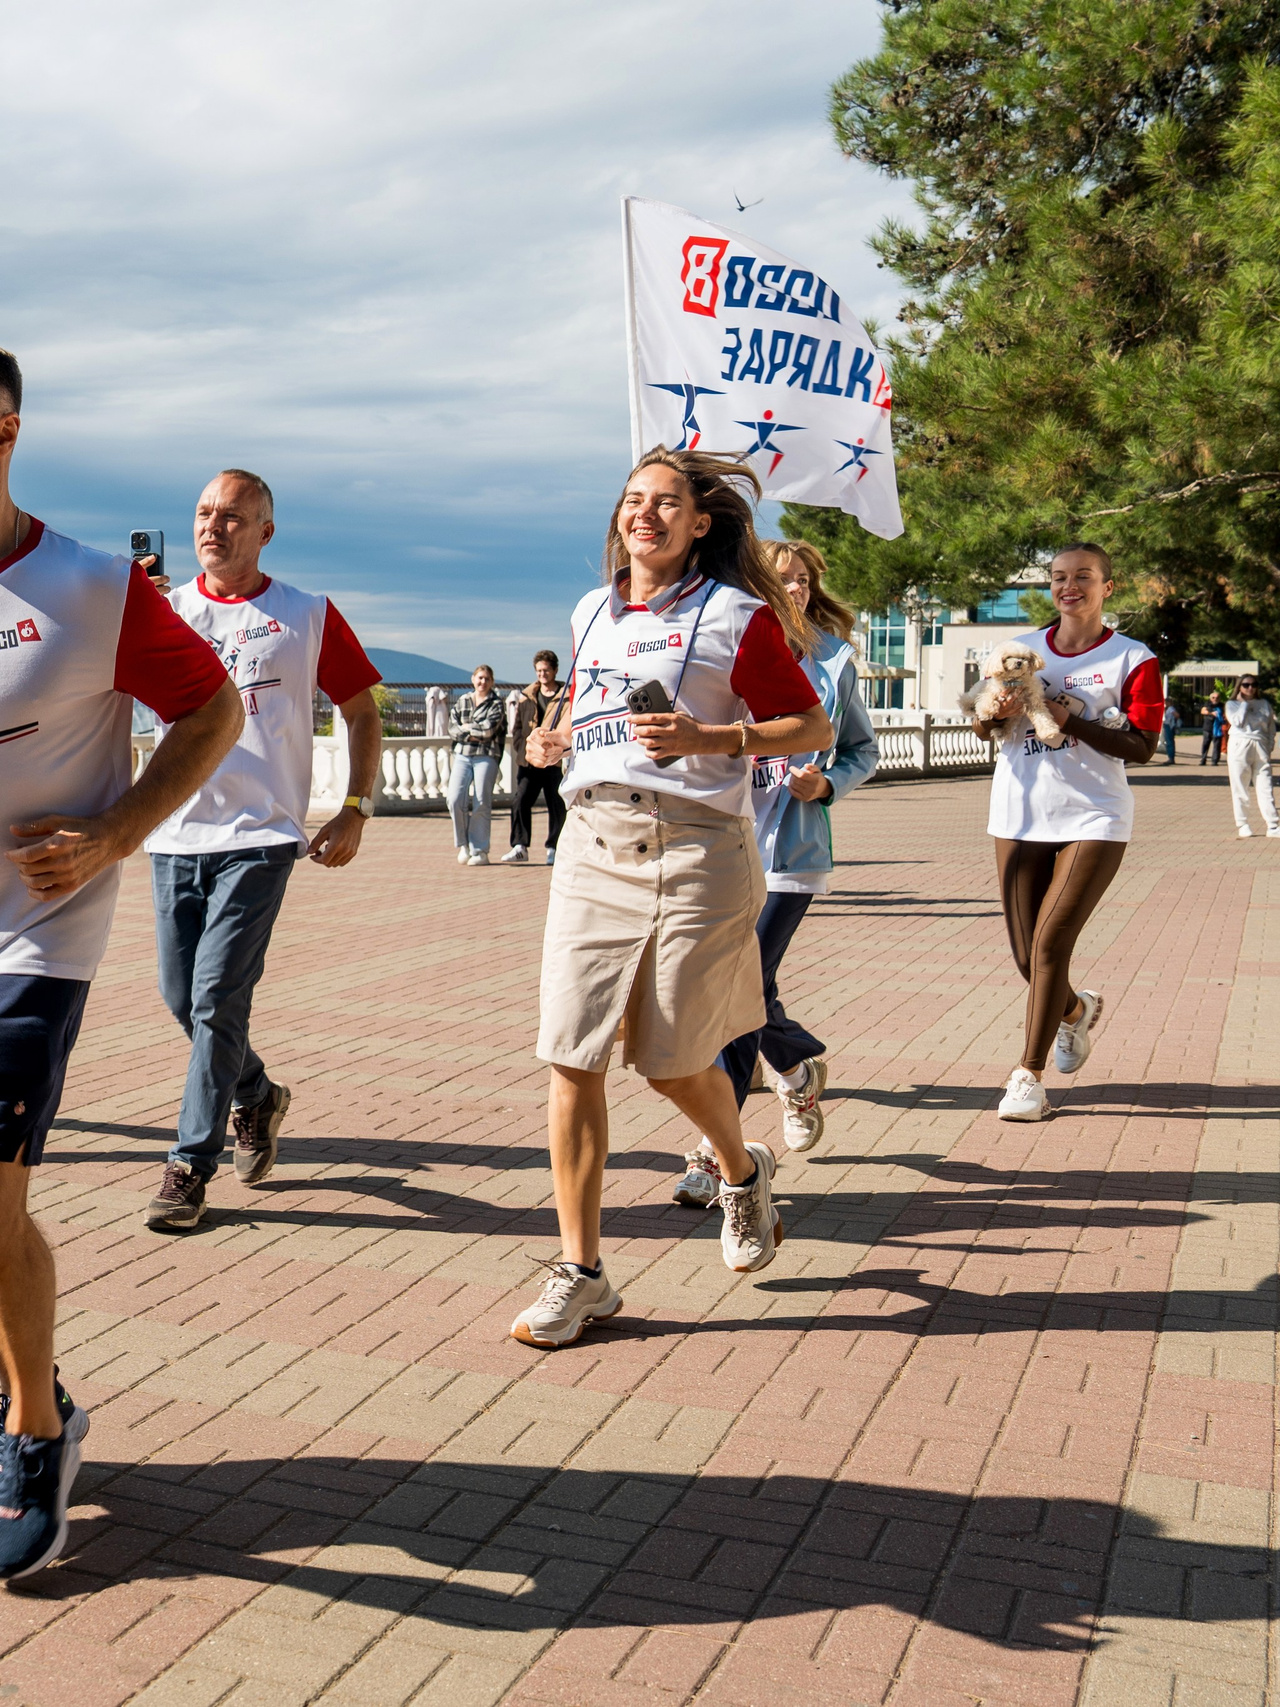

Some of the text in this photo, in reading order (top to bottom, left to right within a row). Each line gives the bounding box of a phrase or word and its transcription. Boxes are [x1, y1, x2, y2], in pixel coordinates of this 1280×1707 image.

[681, 235, 841, 324] BOSCO
[236, 625, 270, 645] BOSCO
[627, 638, 667, 657] BOSCO
[1064, 675, 1094, 690] BOSCO
